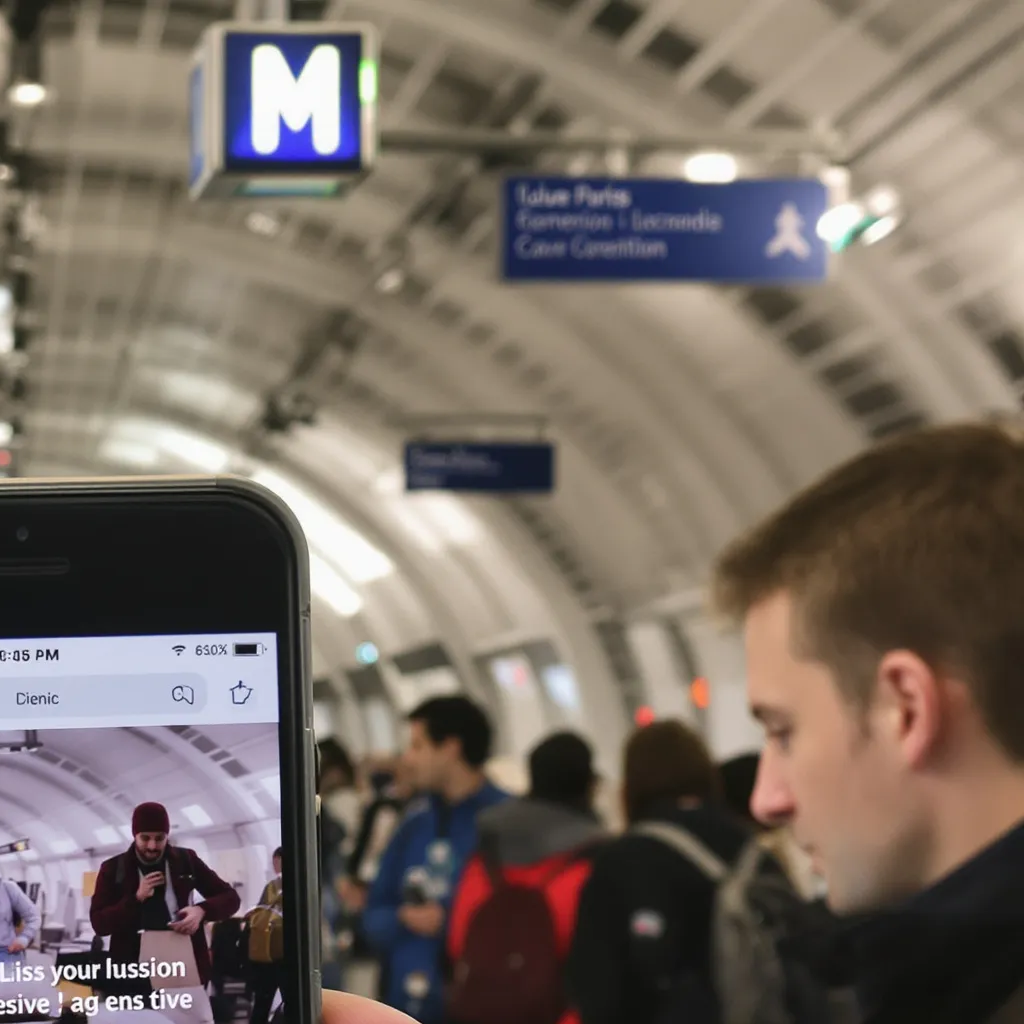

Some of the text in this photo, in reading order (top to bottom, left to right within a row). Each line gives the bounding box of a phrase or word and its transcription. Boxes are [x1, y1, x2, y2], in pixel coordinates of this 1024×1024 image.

[251, 44, 341, 156] M
[36, 649, 59, 660] PM
[50, 963, 101, 987] your
[70, 996, 98, 1017] ag
[105, 993, 145, 1012] ens
[149, 988, 193, 1010] tive
